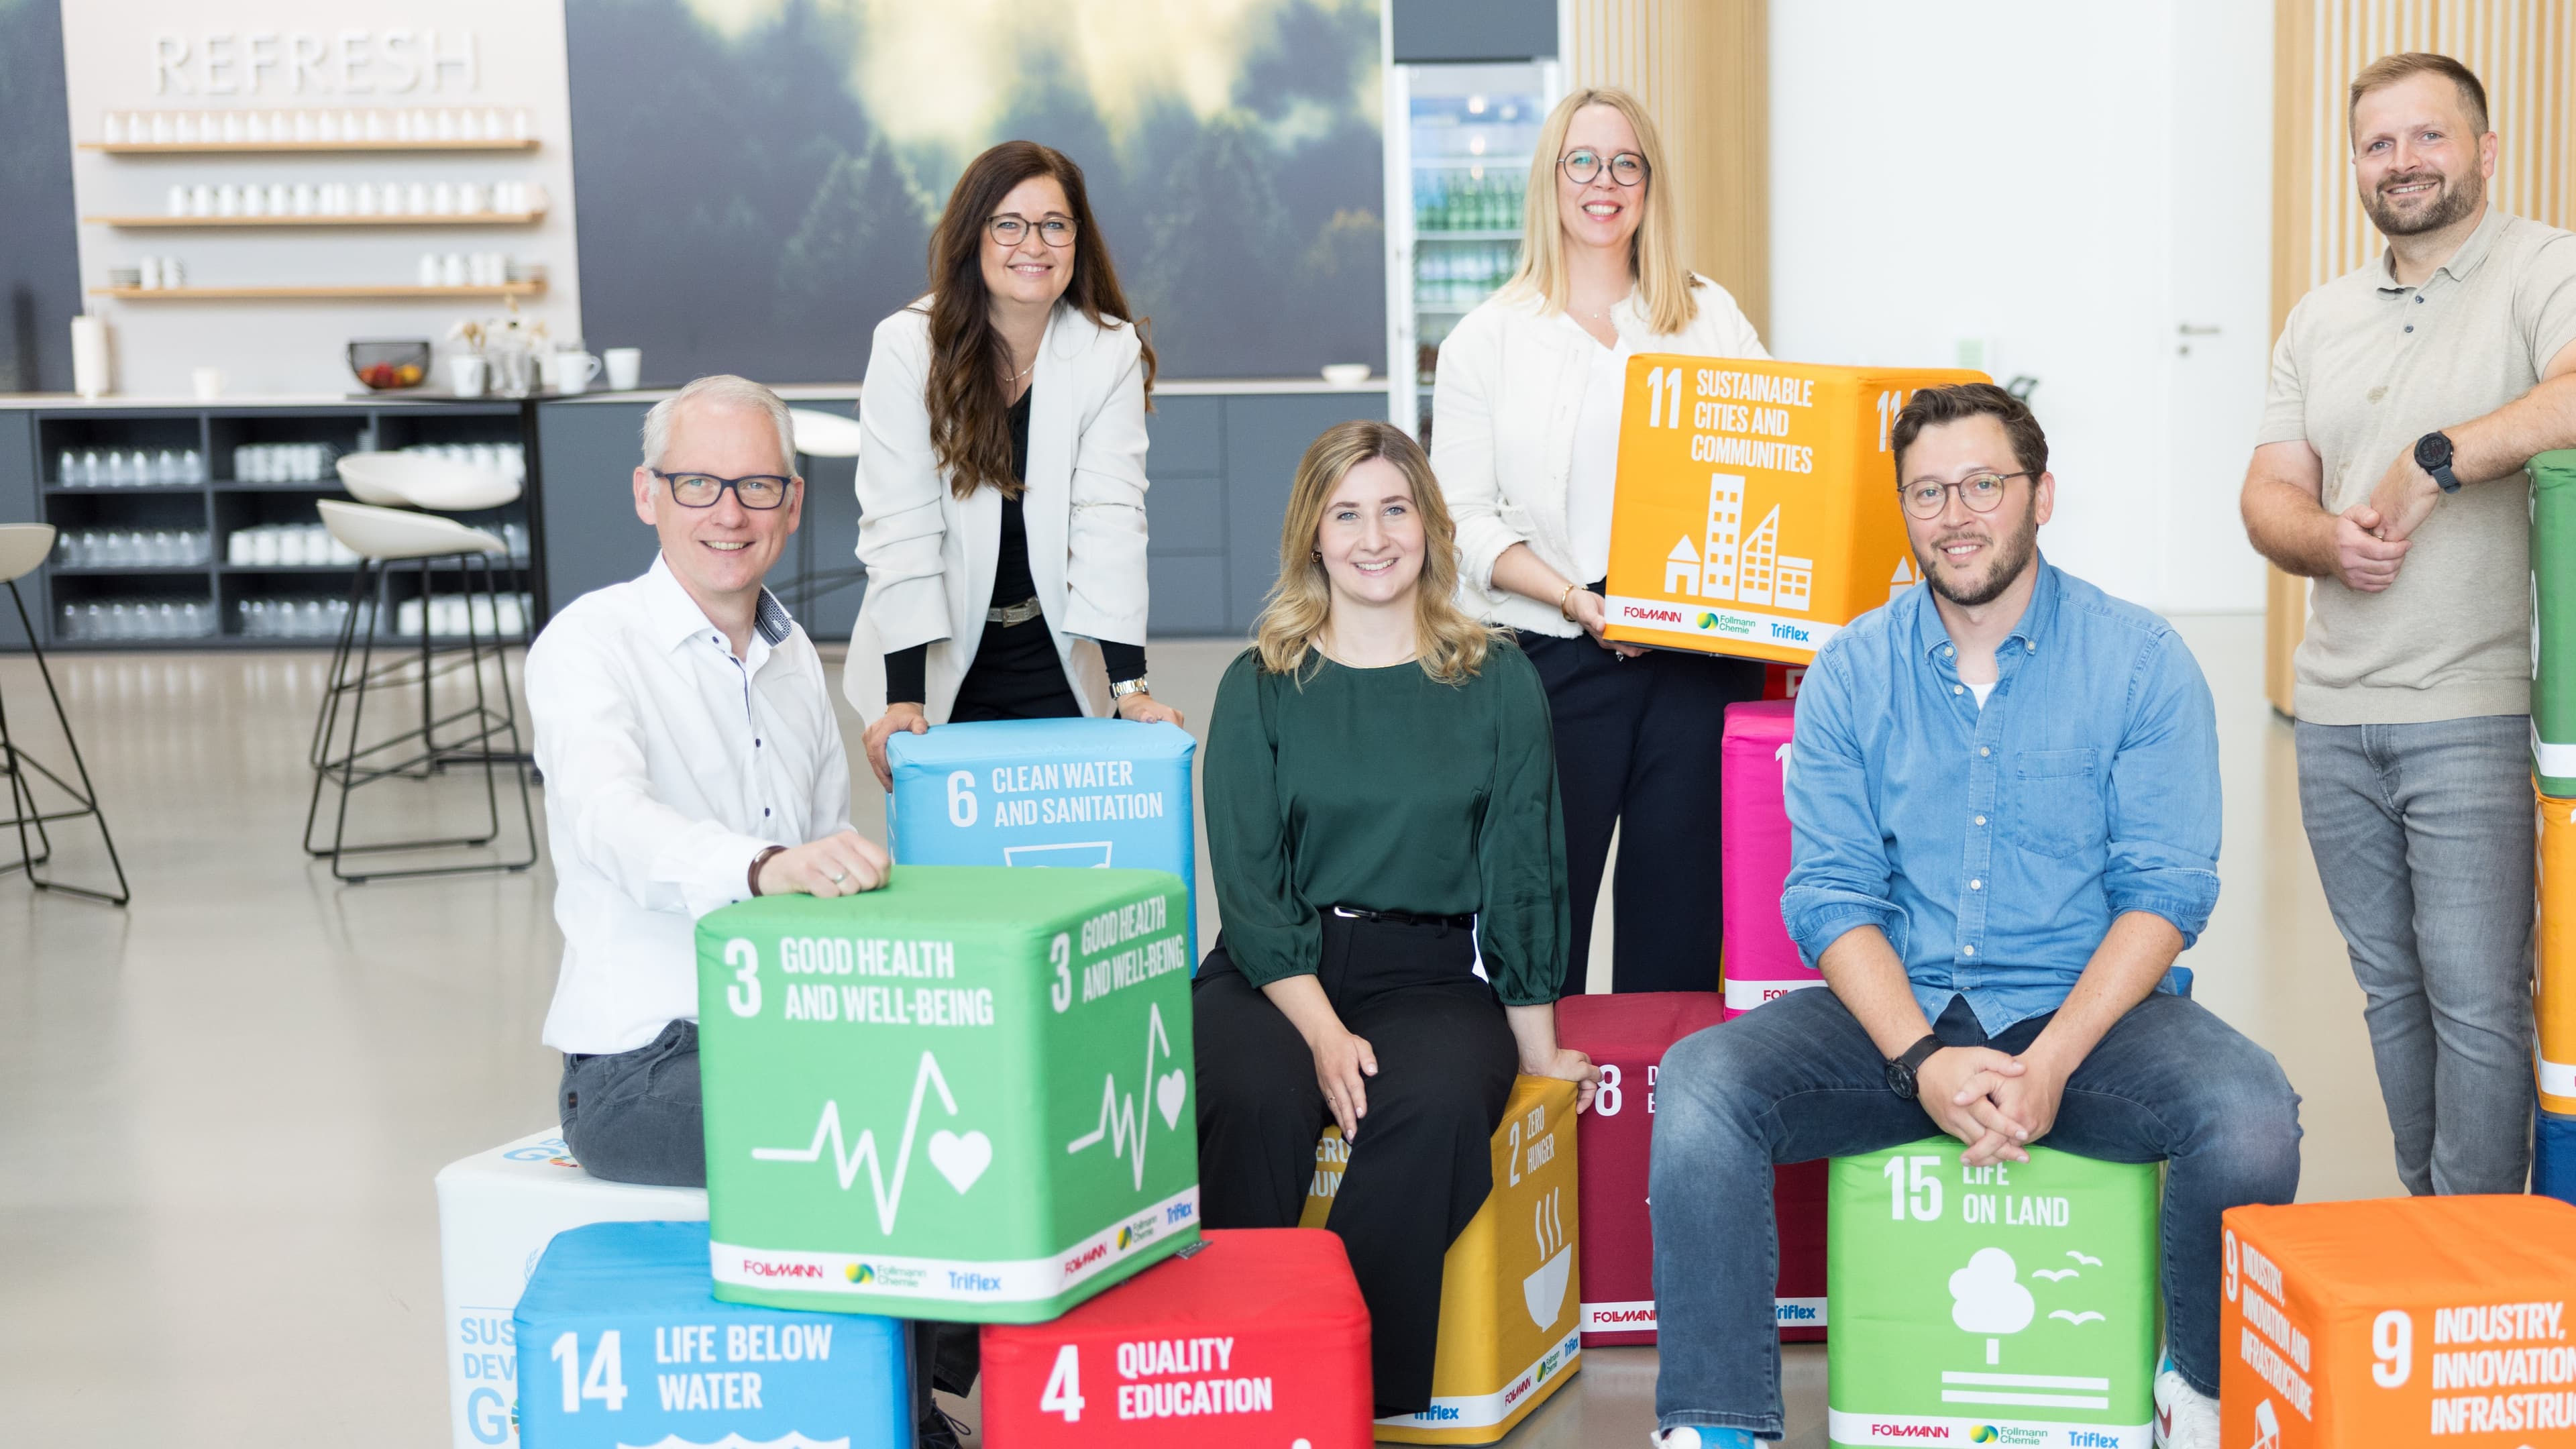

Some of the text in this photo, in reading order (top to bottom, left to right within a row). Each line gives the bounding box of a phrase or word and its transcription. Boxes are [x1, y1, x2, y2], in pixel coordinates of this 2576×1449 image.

[154, 31, 480, 95] REFRESH
[1647, 367, 1814, 429] 11 SUSTAINABLE
[1694, 402, 1789, 437] CITIES AND
[1690, 434, 1813, 474] COMMUNITIES
[1624, 606, 1682, 623] FOLLMANN
[1719, 623, 1750, 635] Chemie
[1720, 614, 1756, 627] Follmann
[1771, 623, 1809, 642] Triflex
[947, 761, 1134, 827] 6 CLEAN WATER
[995, 792, 1164, 827] AND SANITATION
[1050, 895, 1166, 1013] 3 GOOD HEALTH
[1083, 934, 1184, 1004] AND WELL-BEING
[724, 936, 955, 1018] 3 GOOD HEALTH
[785, 984, 994, 1026] AND WELL-BEING
[1595, 1064, 1622, 1116] 8
[1316, 1137, 1352, 1163] ERO
[1509, 1104, 1544, 1188] 2 ZERO
[1527, 1133, 1554, 1175] HUNGER
[1884, 1155, 2010, 1222] 15 LIFE
[1962, 1193, 2070, 1228] ON LAND
[743, 1260, 823, 1279] FOLLMANN
[877, 1265, 926, 1277] Follmann
[877, 1277, 919, 1288] Chemie
[948, 1271, 1001, 1291] Triflex
[2225, 1229, 2285, 1306] 9 INDUSTRY,
[1564, 1336, 1578, 1358] Triflex
[2243, 1283, 2310, 1373] INNOVATION AND
[2371, 1301, 2566, 1389] 9 INDUSTRY,
[551, 1330, 628, 1413] 14
[655, 1326, 716, 1364] LIFE
[727, 1324, 833, 1362] BELOW
[1040, 1337, 1234, 1422] 4 QUALITY
[2241, 1326, 2312, 1422] INFRASTRUCTURE
[657, 1372, 763, 1411] WATER
[1118, 1377, 1273, 1420] EDUCATION
[1505, 1375, 1531, 1407] FOLLMANN
[1872, 1424, 1949, 1438] FOLLMANN
[2000, 1426, 2048, 1438] Follmann
[2430, 1392, 2576, 1435] INFRASTRU
[2000, 1436, 2041, 1446] Chemie
[2069, 1430, 2119, 1449] Triflex
